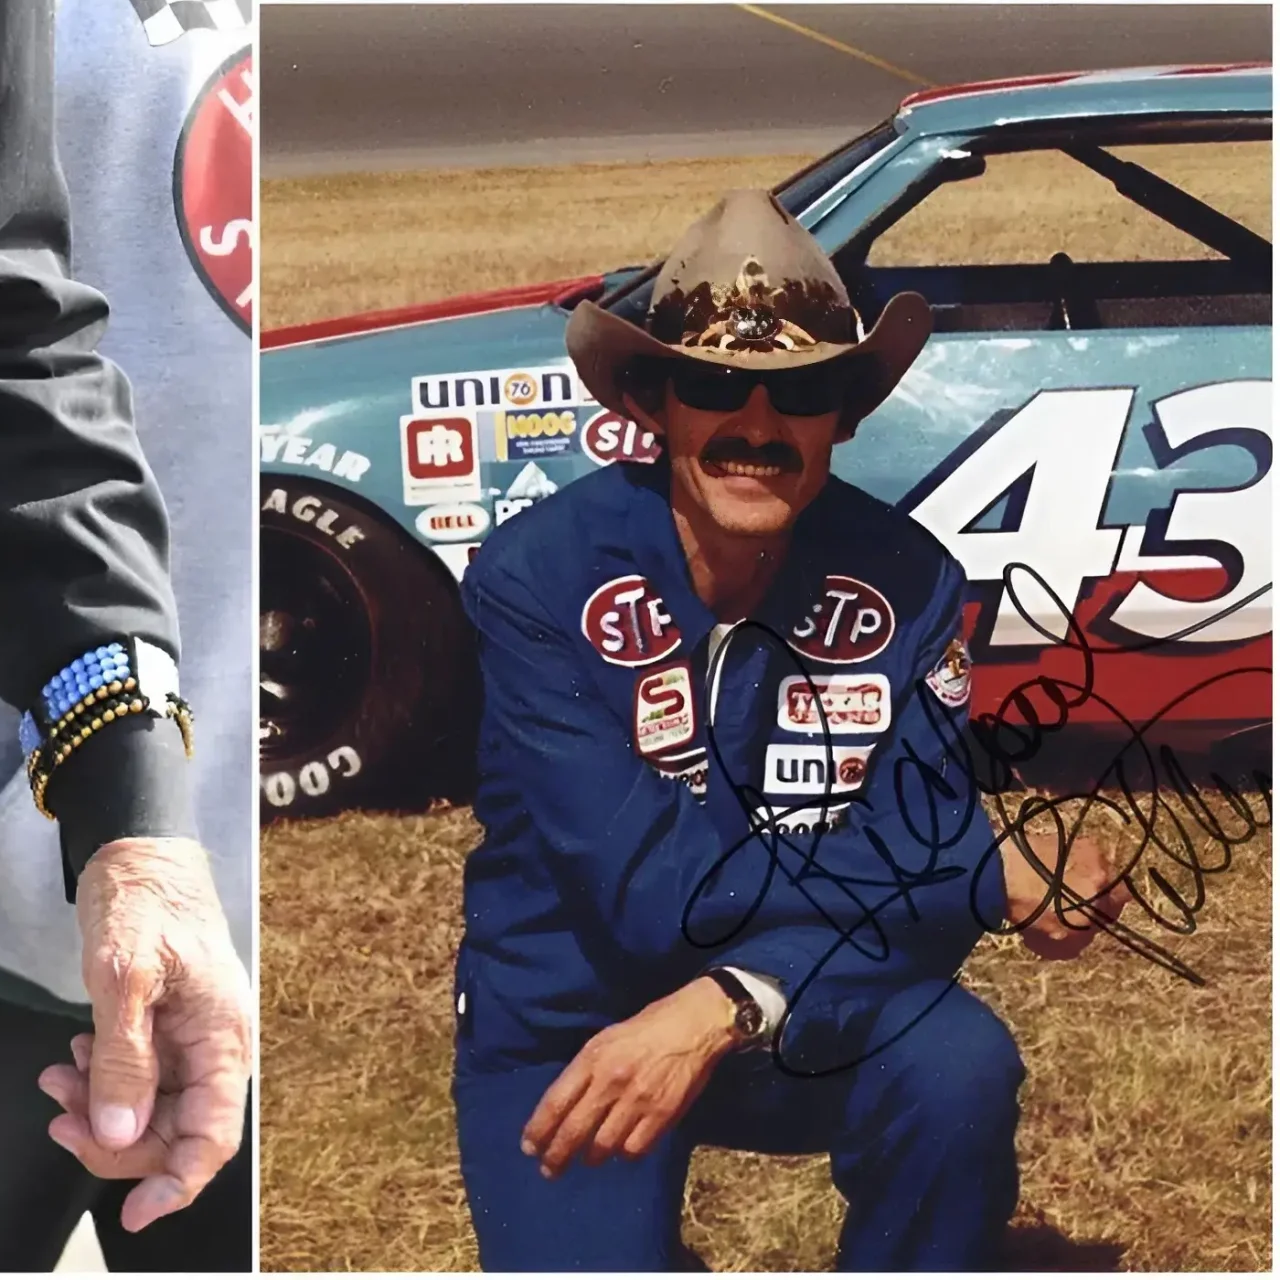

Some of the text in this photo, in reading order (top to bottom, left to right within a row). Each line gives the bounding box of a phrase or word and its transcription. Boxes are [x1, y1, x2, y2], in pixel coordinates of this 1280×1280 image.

[260, 434, 371, 482] YEAR
[261, 488, 366, 550] AGLE
[907, 379, 1272, 646] 43
[261, 745, 362, 808] GOO
